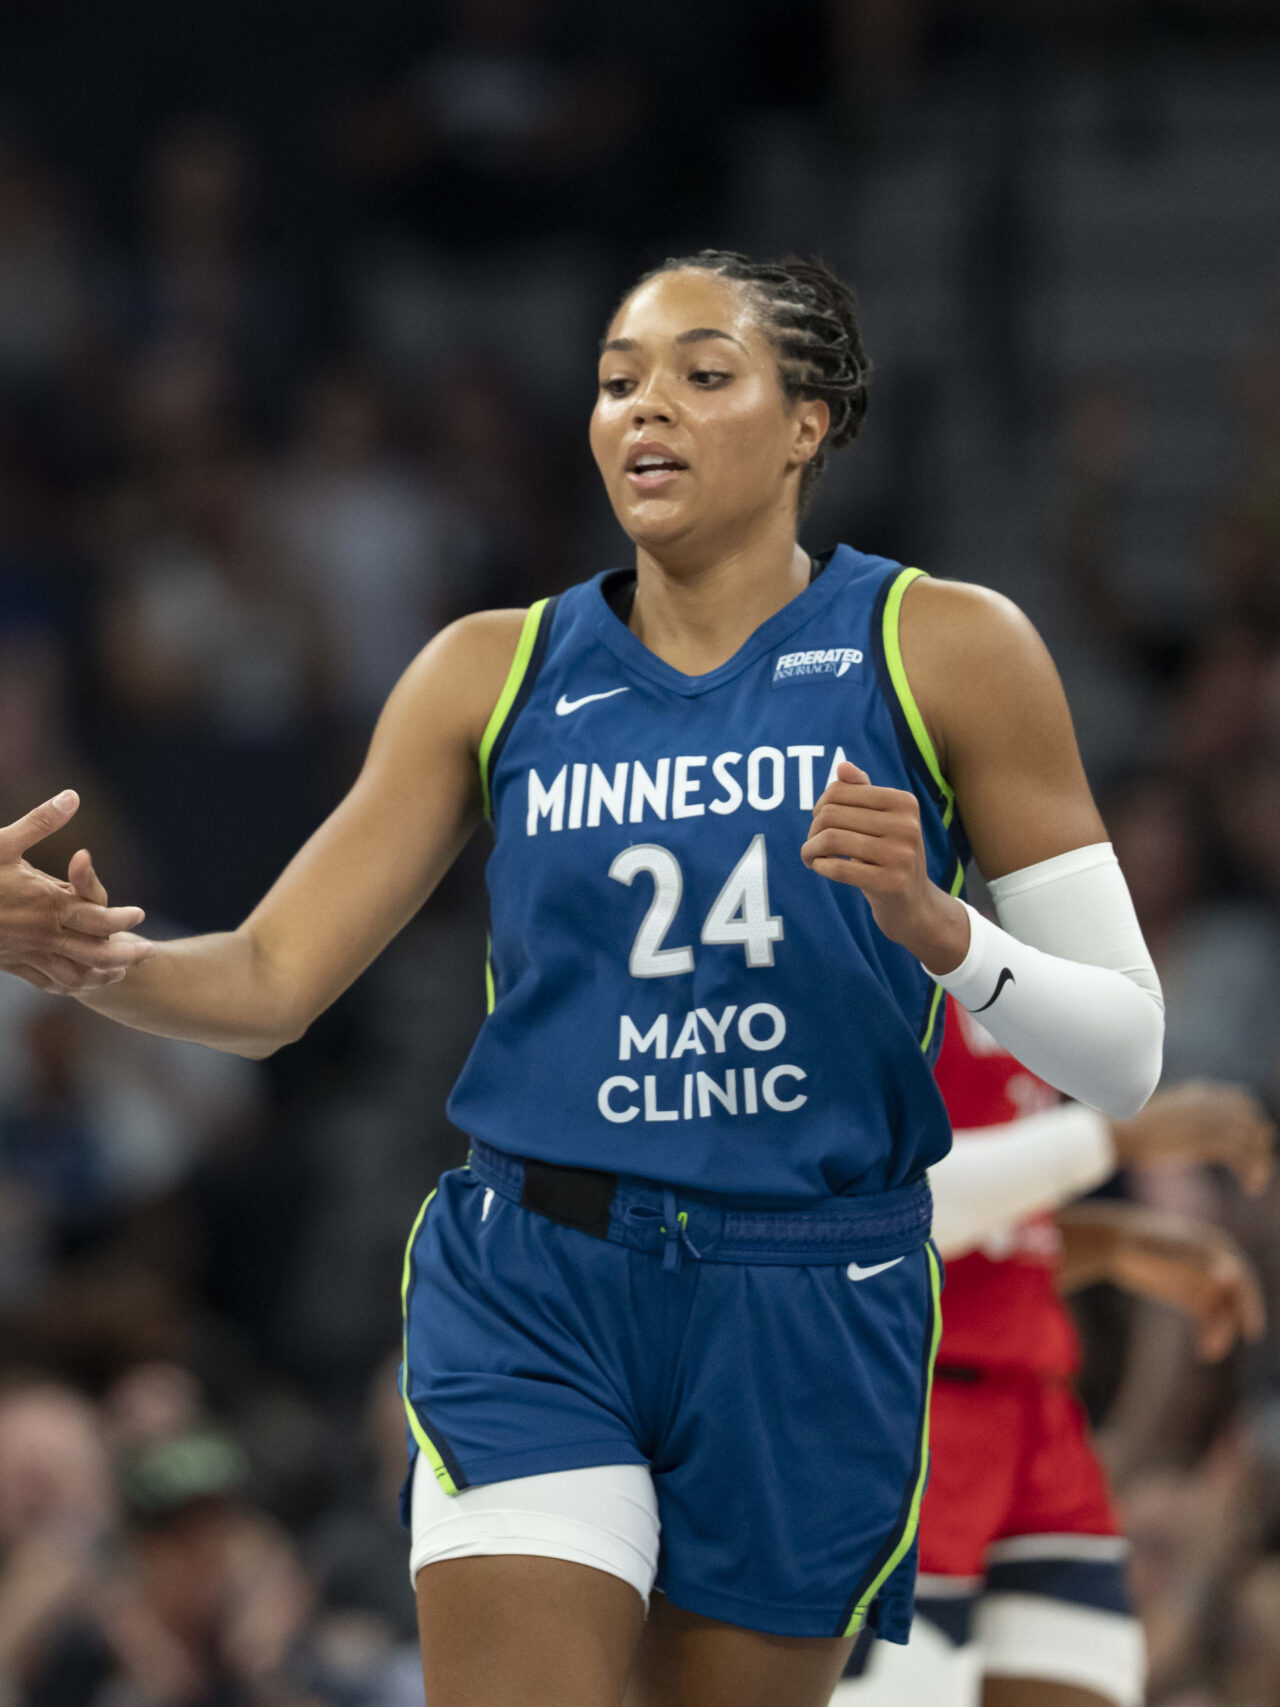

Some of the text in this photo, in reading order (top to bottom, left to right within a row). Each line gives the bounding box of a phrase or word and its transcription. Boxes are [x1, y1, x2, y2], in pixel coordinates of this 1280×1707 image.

[776, 648, 863, 671] FEDERATED
[608, 834, 784, 978] 24
[618, 1003, 786, 1061] MAYO
[597, 1064, 808, 1124] CLINIC
